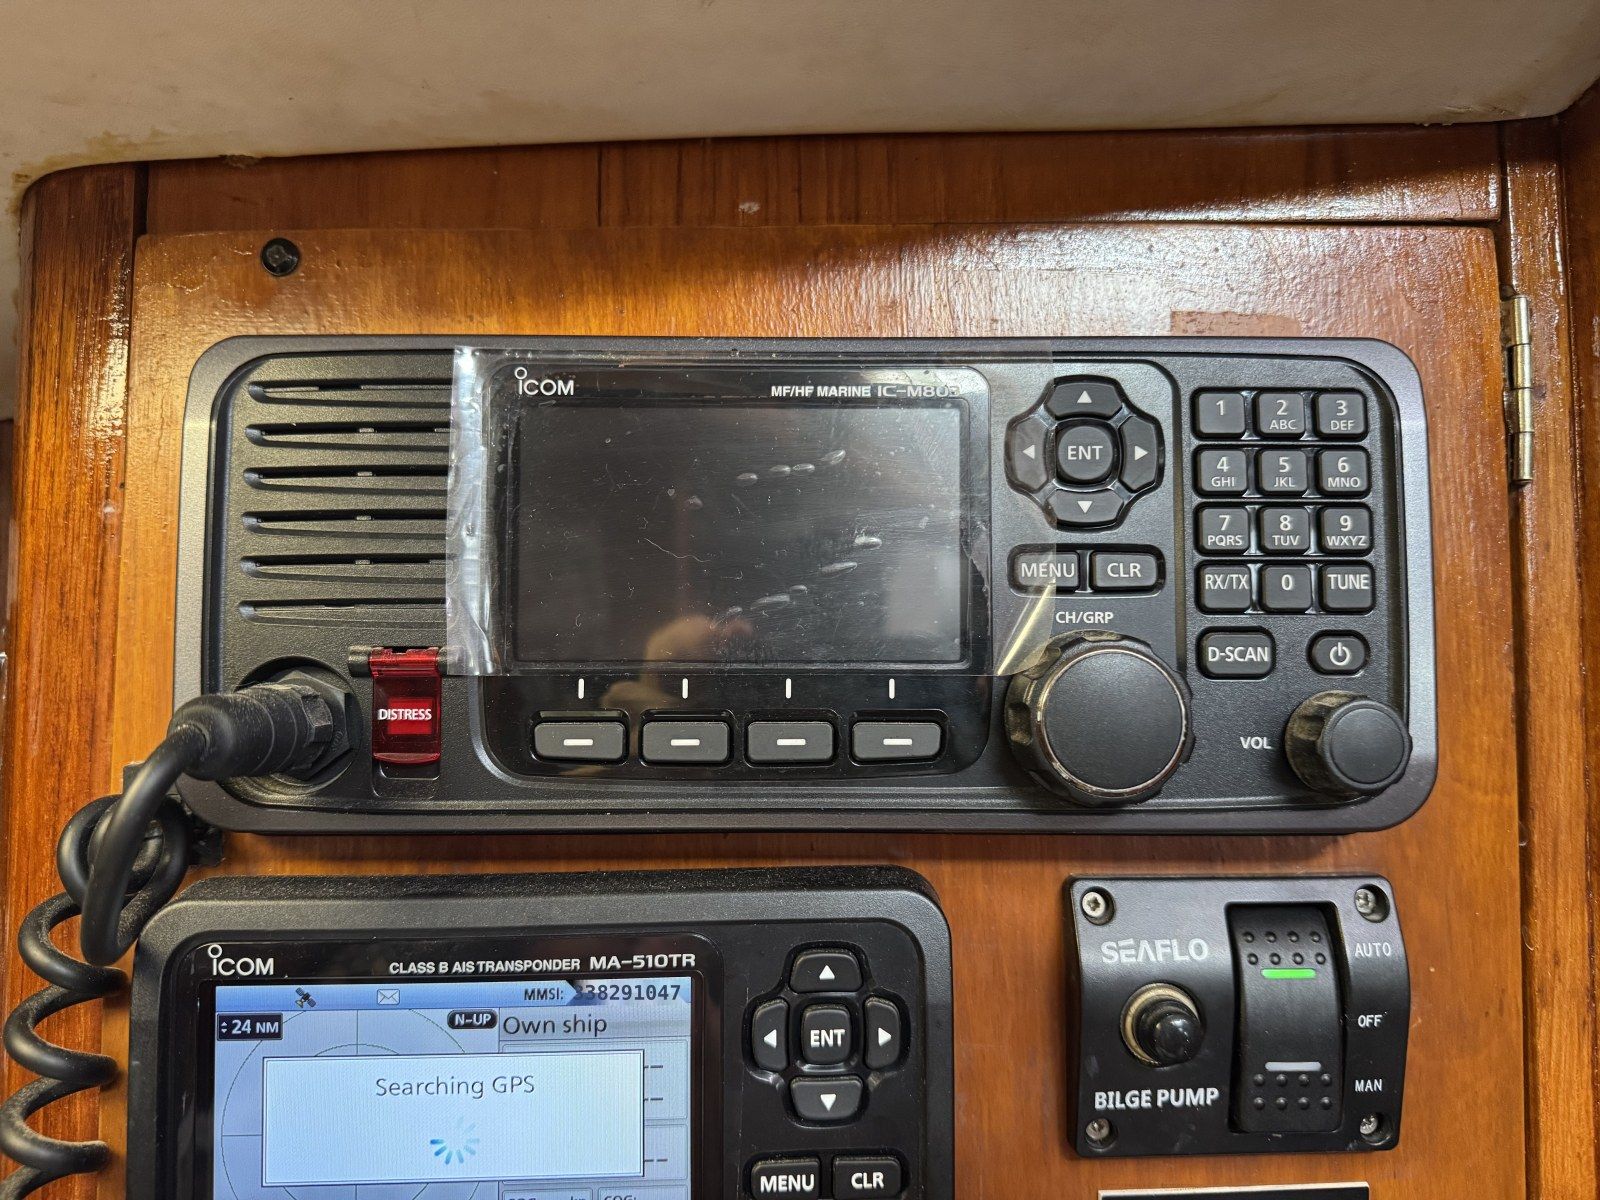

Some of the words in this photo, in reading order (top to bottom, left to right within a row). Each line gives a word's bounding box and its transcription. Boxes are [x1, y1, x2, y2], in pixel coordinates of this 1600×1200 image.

[771, 385, 814, 397] MF/HF
[816, 385, 871, 397] MARINE
[1216, 400, 1225, 415] 1
[1276, 399, 1288, 416] 2
[1336, 399, 1348, 416] 3
[1269, 419, 1297, 430] ABC
[1330, 419, 1354, 431] DEF
[1067, 445, 1104, 460] ENT
[1216, 456, 1230, 473] 4
[1279, 456, 1290, 473] 5
[1337, 456, 1350, 473] 6
[1211, 476, 1235, 488] GHI
[1273, 476, 1296, 488] JKL
[1327, 476, 1361, 488] MNO
[1218, 514, 1230, 531] 7
[1279, 514, 1292, 531] 8
[1339, 515, 1352, 532] 9
[1207, 534, 1243, 547] PQRS
[1271, 534, 1301, 546] TUV
[1326, 534, 1367, 547] WXYZ
[1021, 561, 1075, 580] MENU
[1107, 562, 1142, 578] CLR
[1205, 574, 1249, 590] RX/TX
[1281, 574, 1293, 591] 0
[1327, 573, 1370, 590] TUNE
[1055, 611, 1114, 624] CH/GRP
[1208, 646, 1269, 662] D-SCAN
[377, 708, 433, 721] DISTRESS
[1239, 736, 1272, 750] VOL
[1101, 938, 1209, 963] SEAFLO
[1354, 942, 1392, 957] AUTO
[389, 961, 436, 975] CLASS
[438, 961, 449, 974] B
[451, 960, 476, 973] AIS
[476, 958, 581, 973] TRANSPONDER
[589, 953, 696, 970] MA-510TR
[524, 988, 564, 1001] MMSI:
[231, 1019, 251, 1035] 24
[255, 1021, 279, 1034] NM
[454, 1012, 491, 1026] N-UP
[503, 1016, 556, 1035] Own
[563, 1013, 608, 1037] ship
[1357, 1014, 1382, 1028] OFF
[810, 1028, 846, 1048] ENT
[375, 1077, 484, 1100] Searching
[492, 1076, 535, 1094] GPS
[1354, 1078, 1383, 1092] MAN
[1094, 1090, 1152, 1110] BILGE
[1156, 1087, 1220, 1107] PUMP
[760, 1173, 815, 1193] MENU
[851, 1172, 885, 1189] CLR
